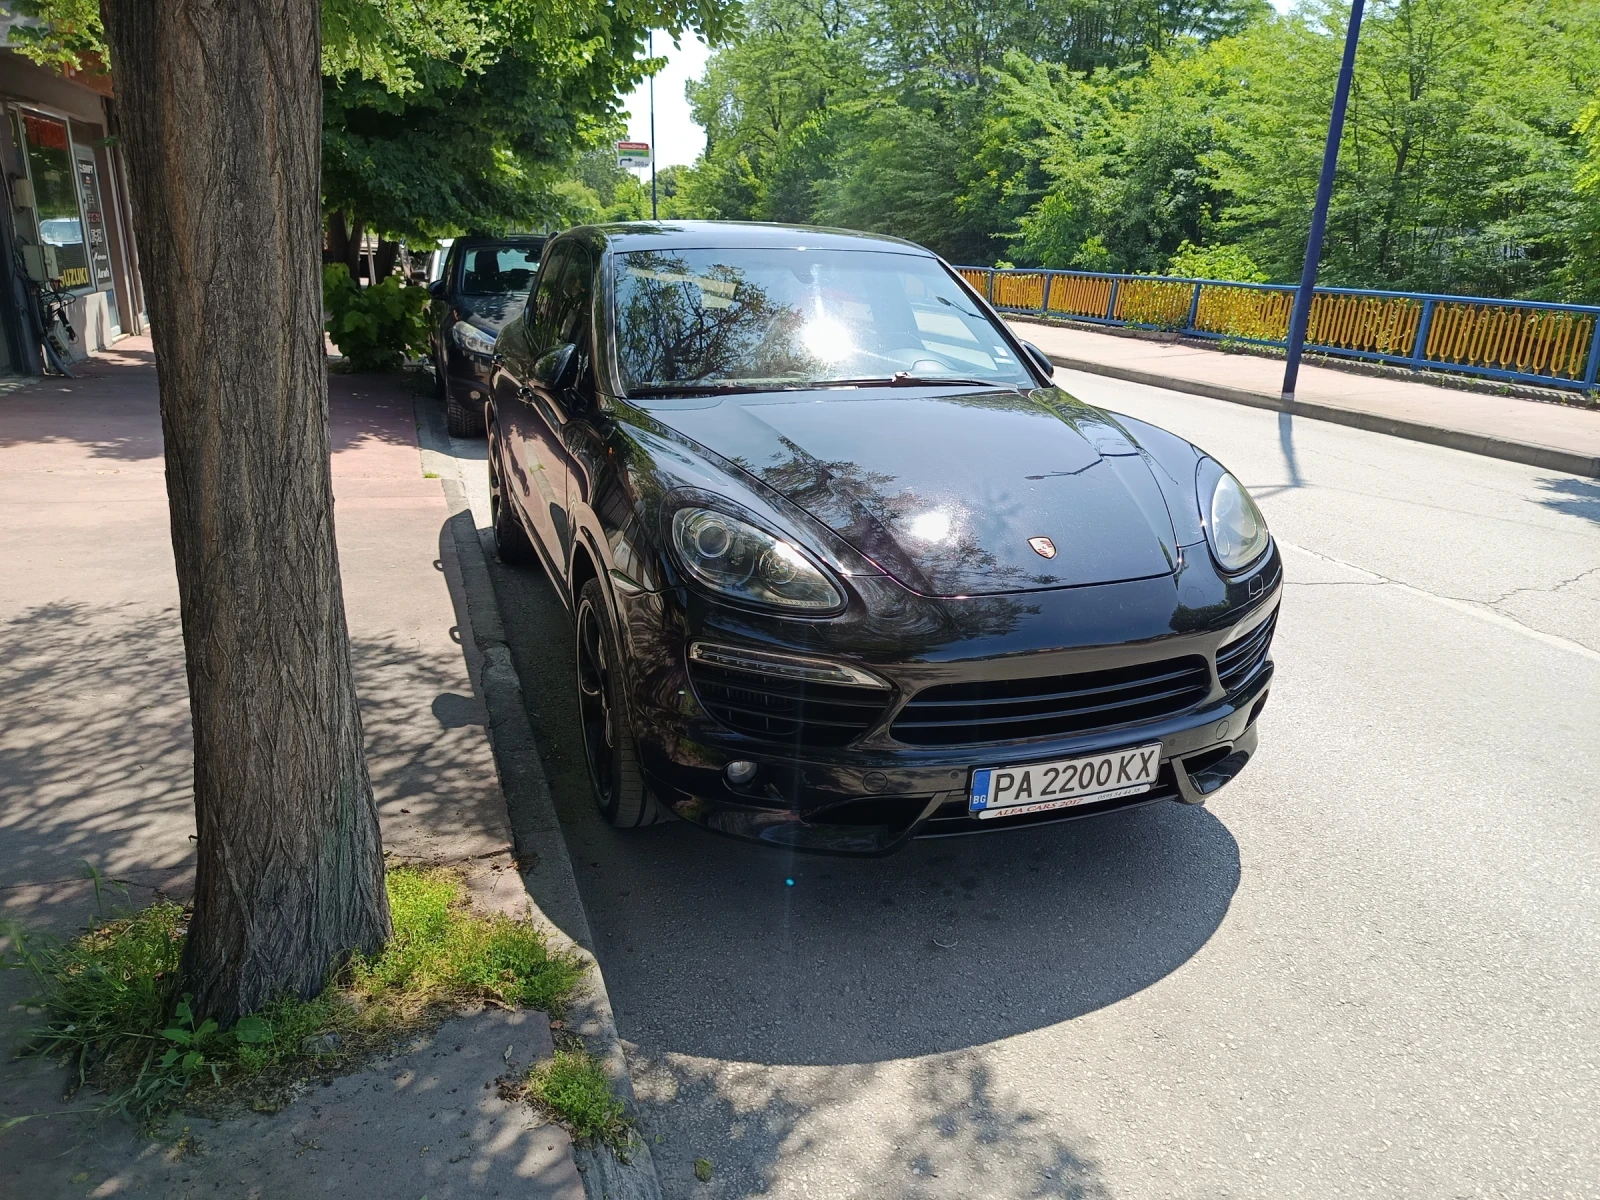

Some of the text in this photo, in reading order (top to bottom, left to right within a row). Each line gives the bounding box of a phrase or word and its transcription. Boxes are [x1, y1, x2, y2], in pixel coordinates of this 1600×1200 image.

[993, 750, 1155, 802] PA 2200 KX
[973, 795, 986, 804] BG
[994, 798, 1084, 816] ALFA CARS 2017
